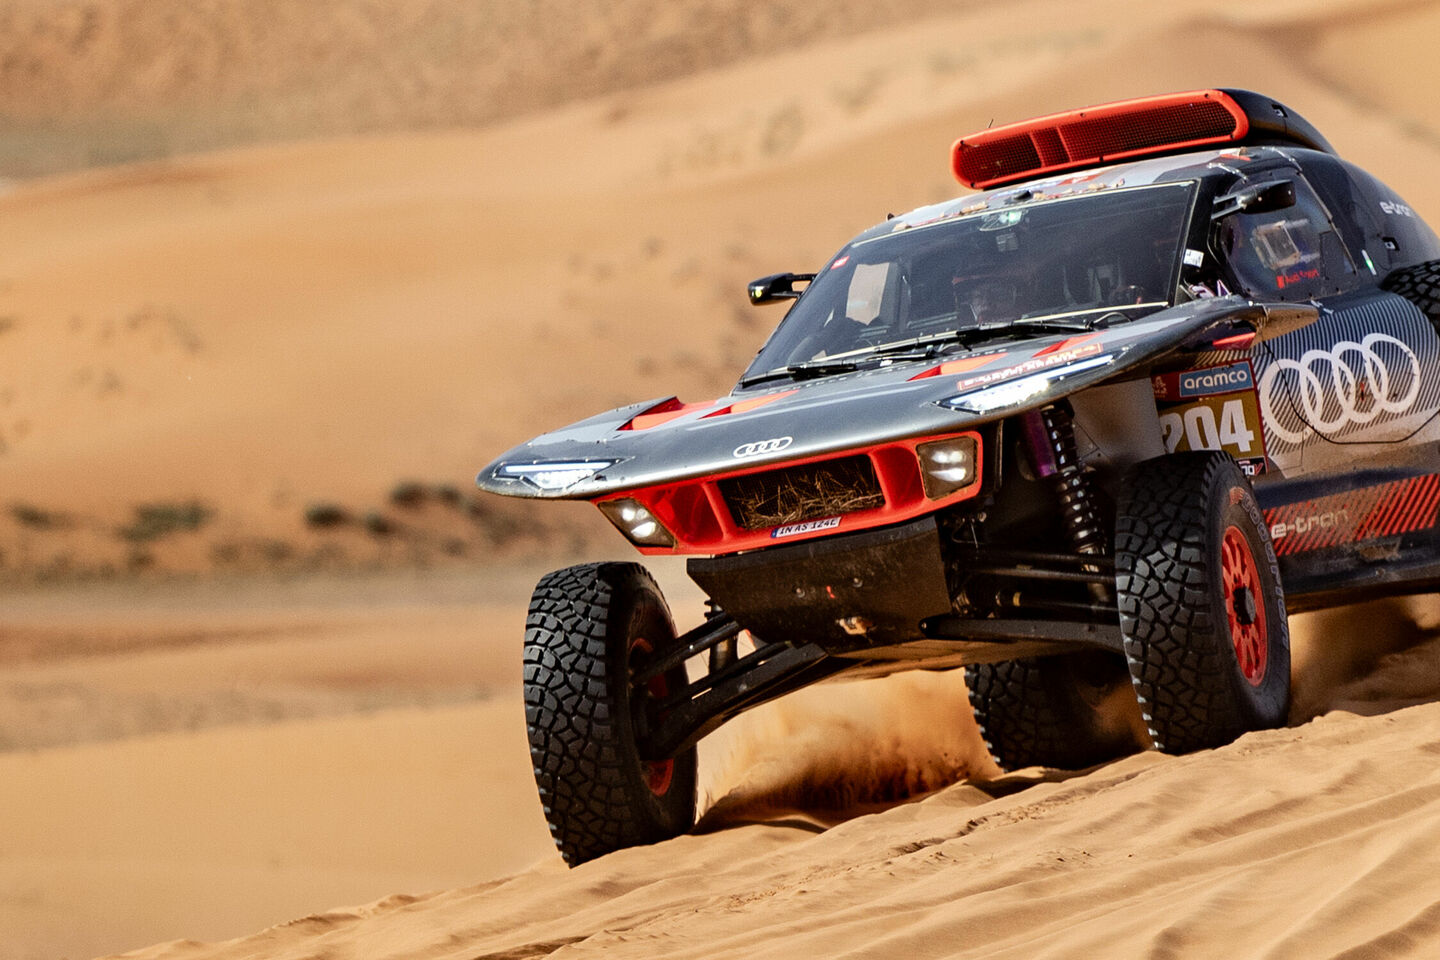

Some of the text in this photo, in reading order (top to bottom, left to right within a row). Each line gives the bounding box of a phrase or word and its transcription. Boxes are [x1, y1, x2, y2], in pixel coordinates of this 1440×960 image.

[1184, 370, 1248, 389] aramco
[1160, 400, 1255, 454] 204
[780, 527, 793, 535] IN
[794, 523, 808, 532] AS
[1271, 509, 1349, 539] e-tron
